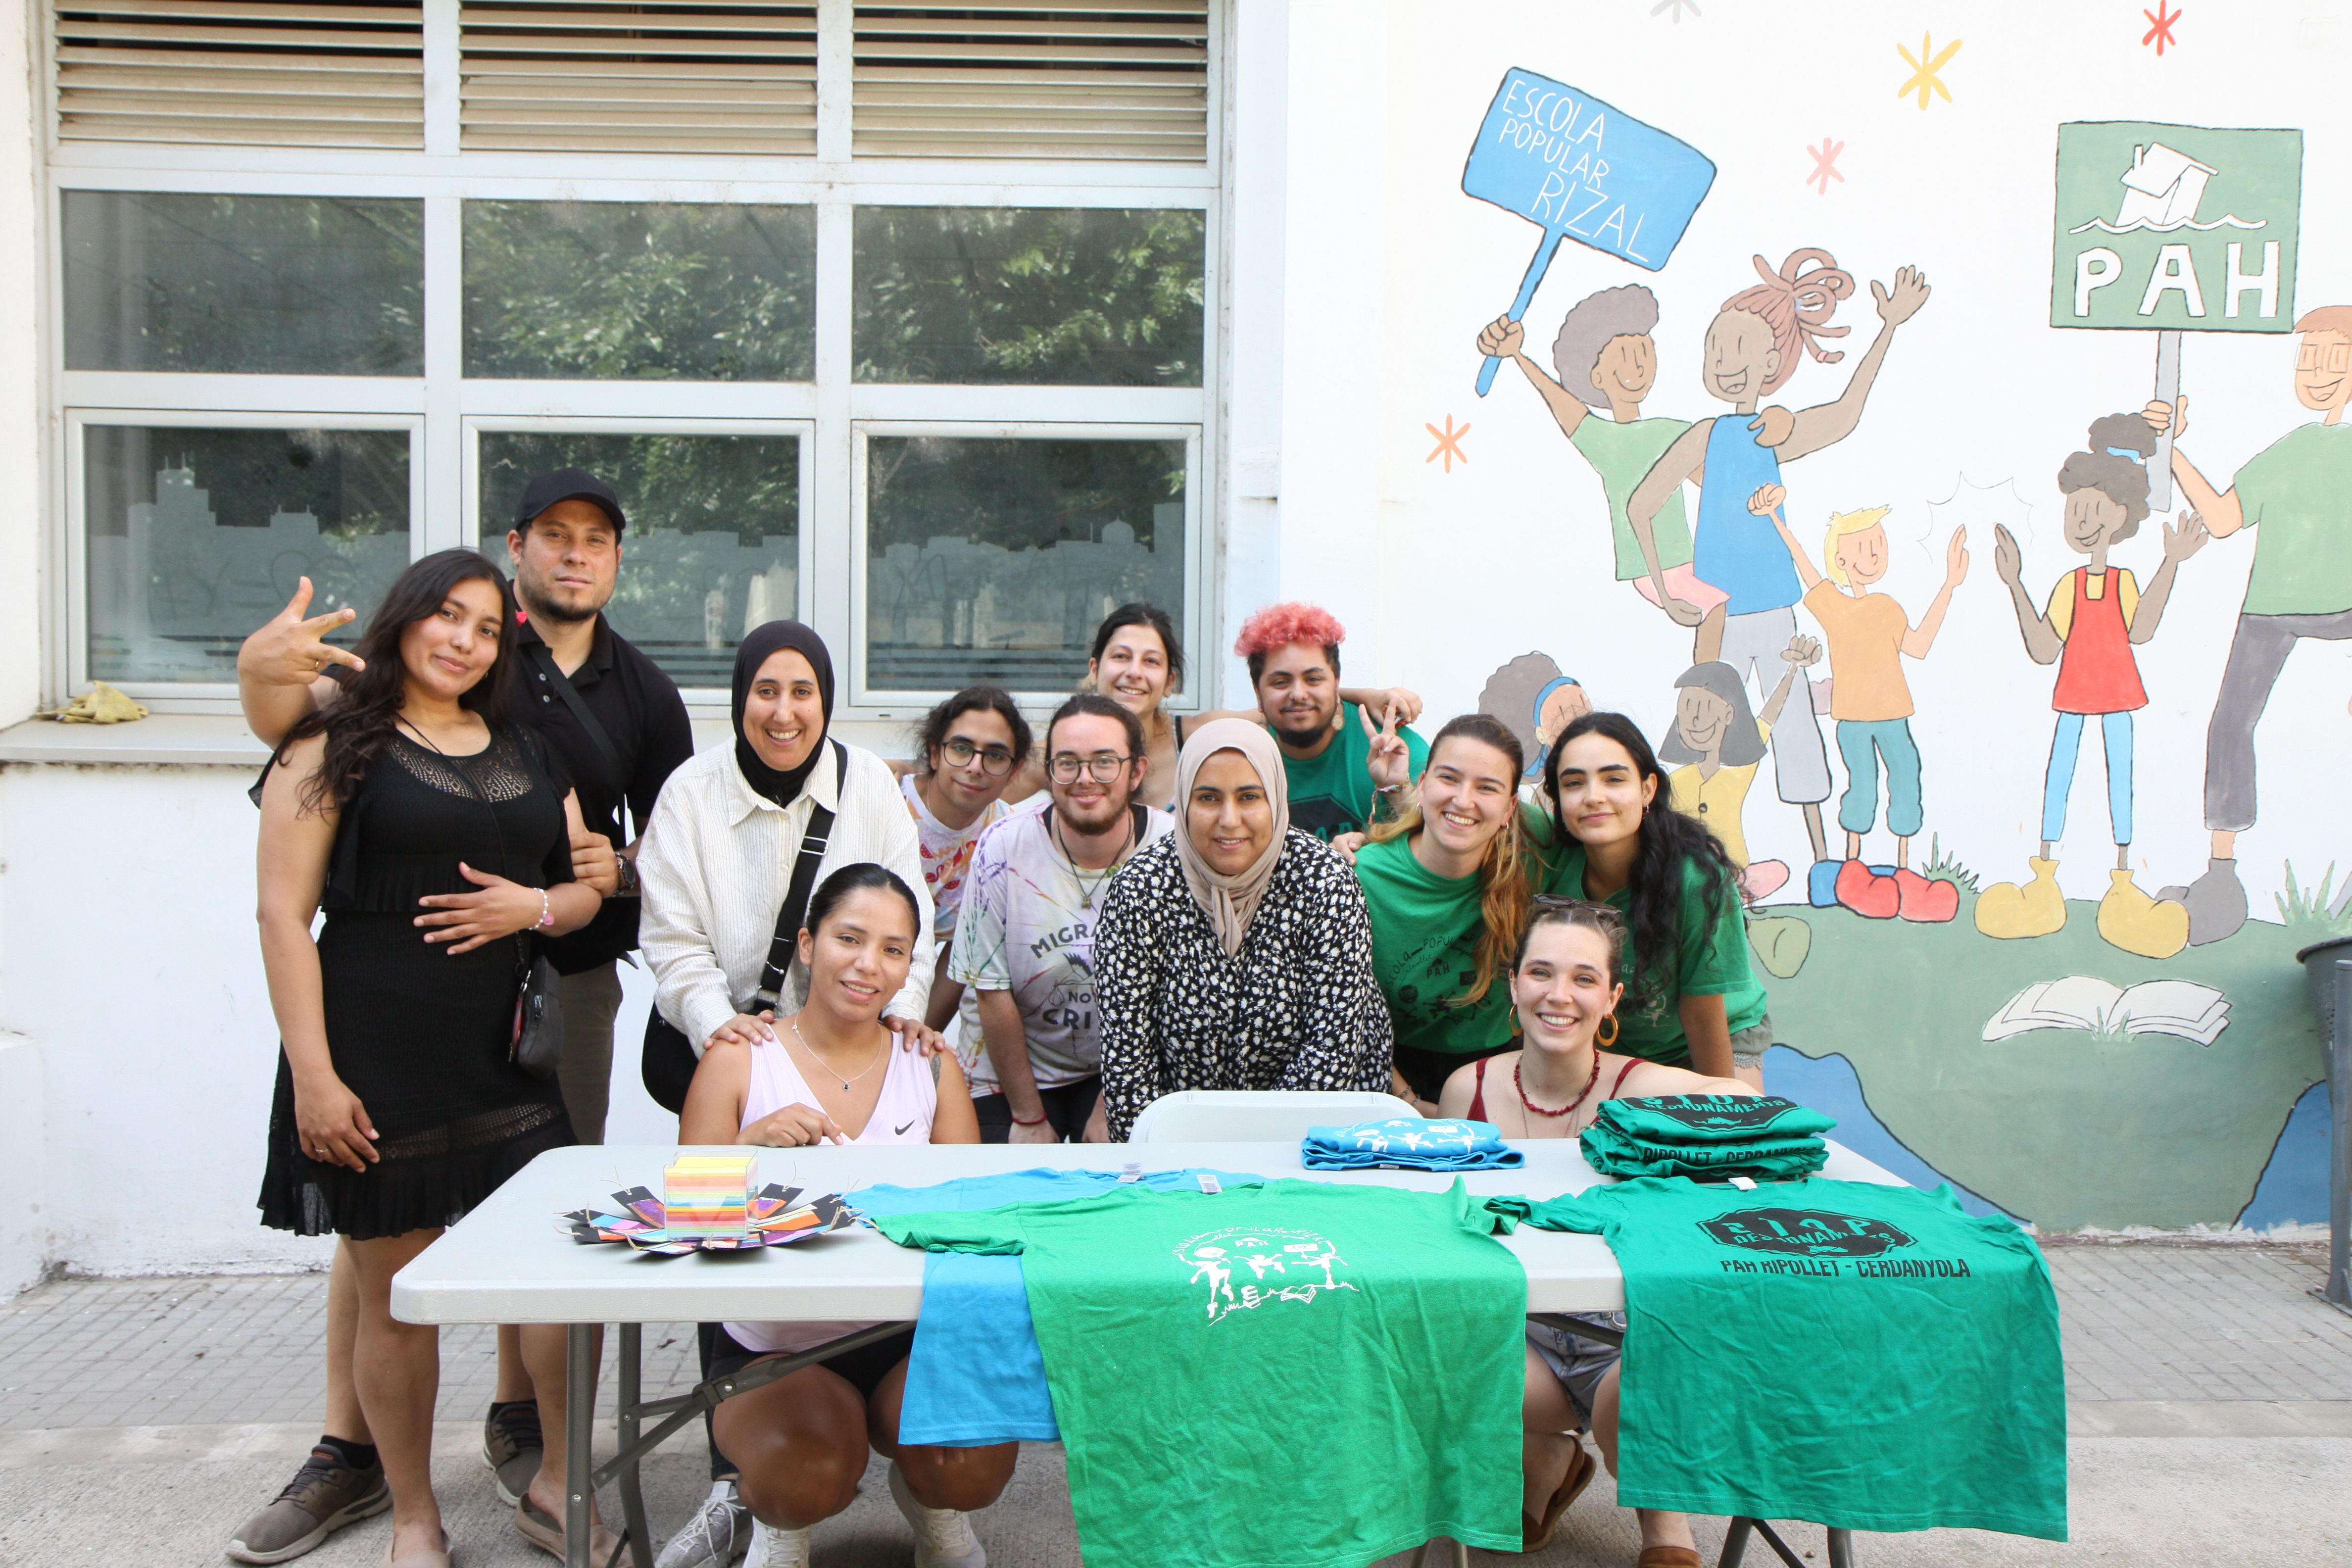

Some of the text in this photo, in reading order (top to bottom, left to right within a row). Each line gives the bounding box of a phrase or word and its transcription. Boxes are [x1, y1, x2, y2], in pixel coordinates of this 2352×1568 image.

[1503, 79, 1604, 152] ESCOLA
[1499, 118, 1610, 189] POPULAR
[1530, 171, 1649, 262] RIZAL
[2074, 241, 2280, 318] PAH
[1426, 963, 1450, 979] PAH
[1720, 1260, 1758, 1273] PAH
[1760, 1259, 1840, 1277] RIPOLLET
[1855, 1258, 1971, 1278] CERDANYOLA
